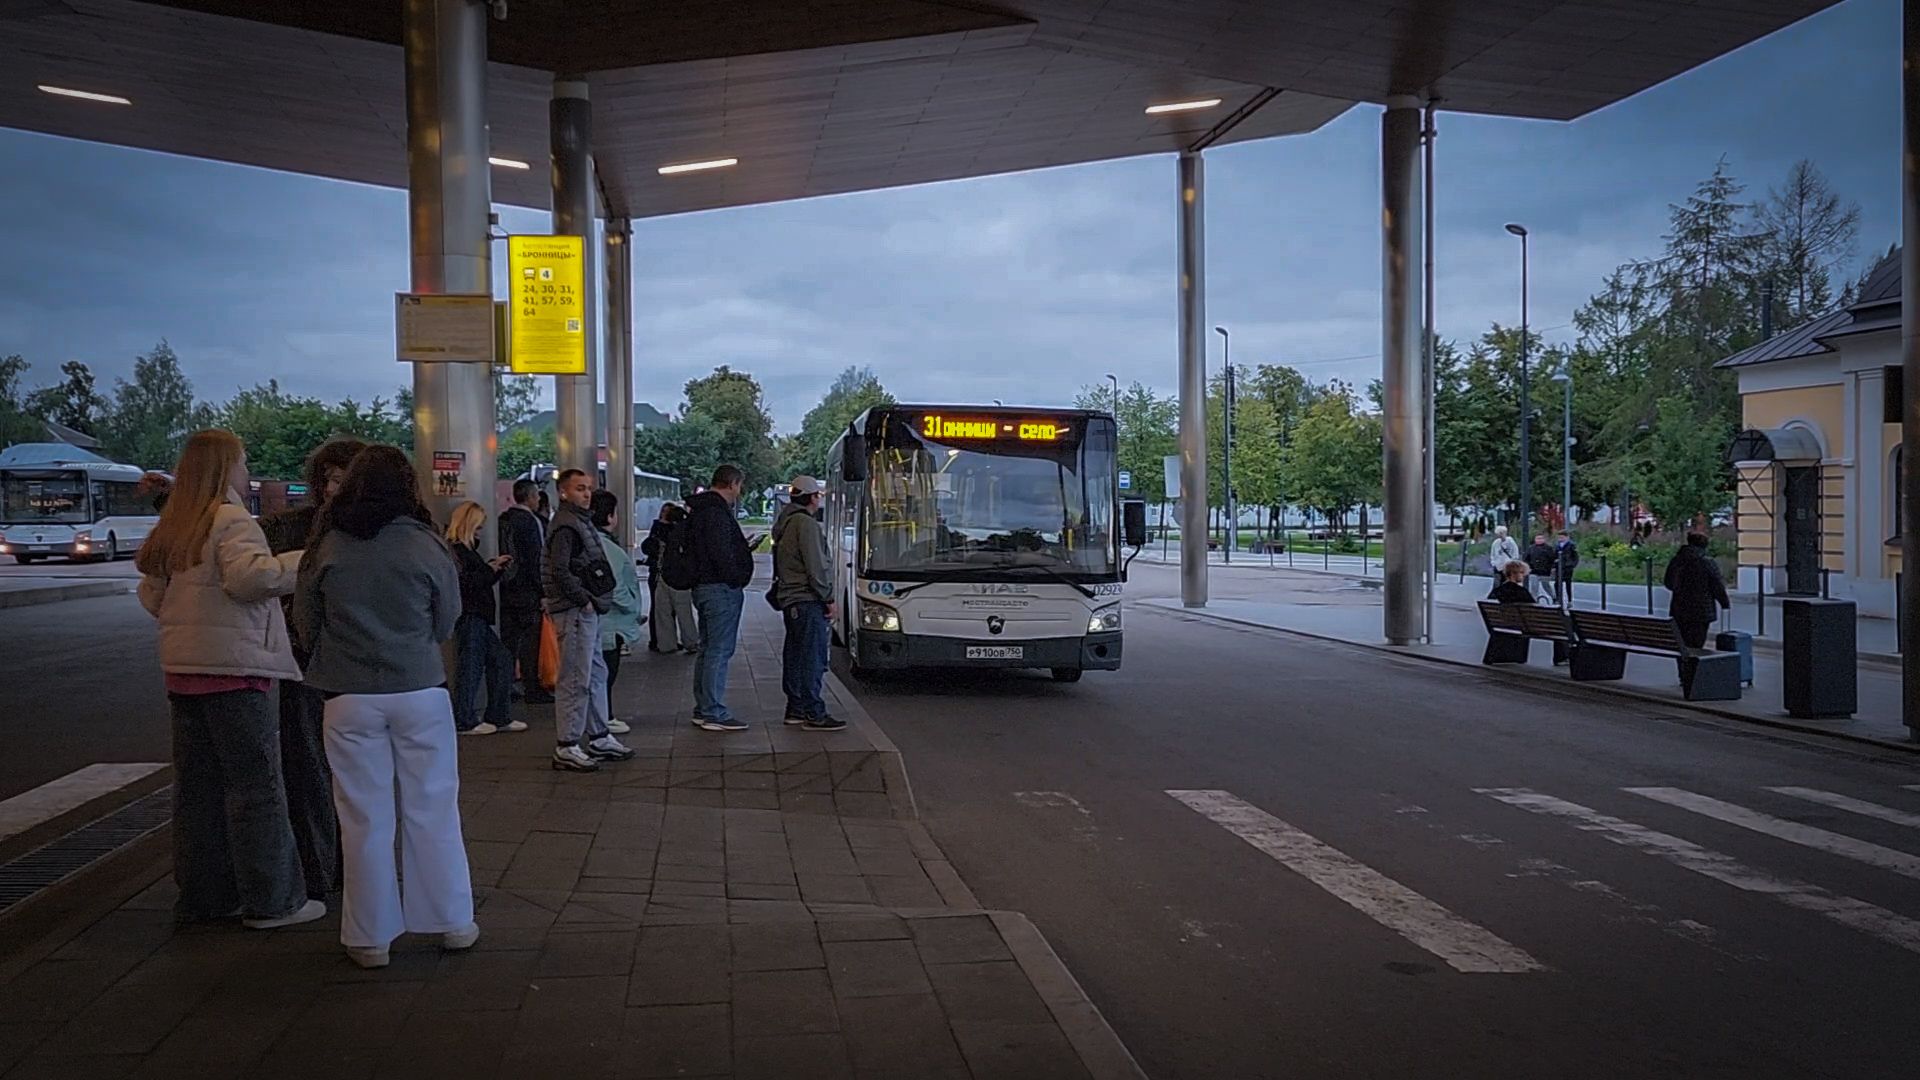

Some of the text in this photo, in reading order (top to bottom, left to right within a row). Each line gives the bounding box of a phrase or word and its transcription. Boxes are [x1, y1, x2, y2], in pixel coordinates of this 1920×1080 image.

[543, 270, 550, 279] 4
[523, 285, 574, 295] 24, 30, 31,
[523, 297, 538, 306] 41,
[541, 297, 557, 306] 57,
[523, 308, 536, 317] 64
[924, 416, 941, 437] 31
[1019, 424, 1056, 440] село
